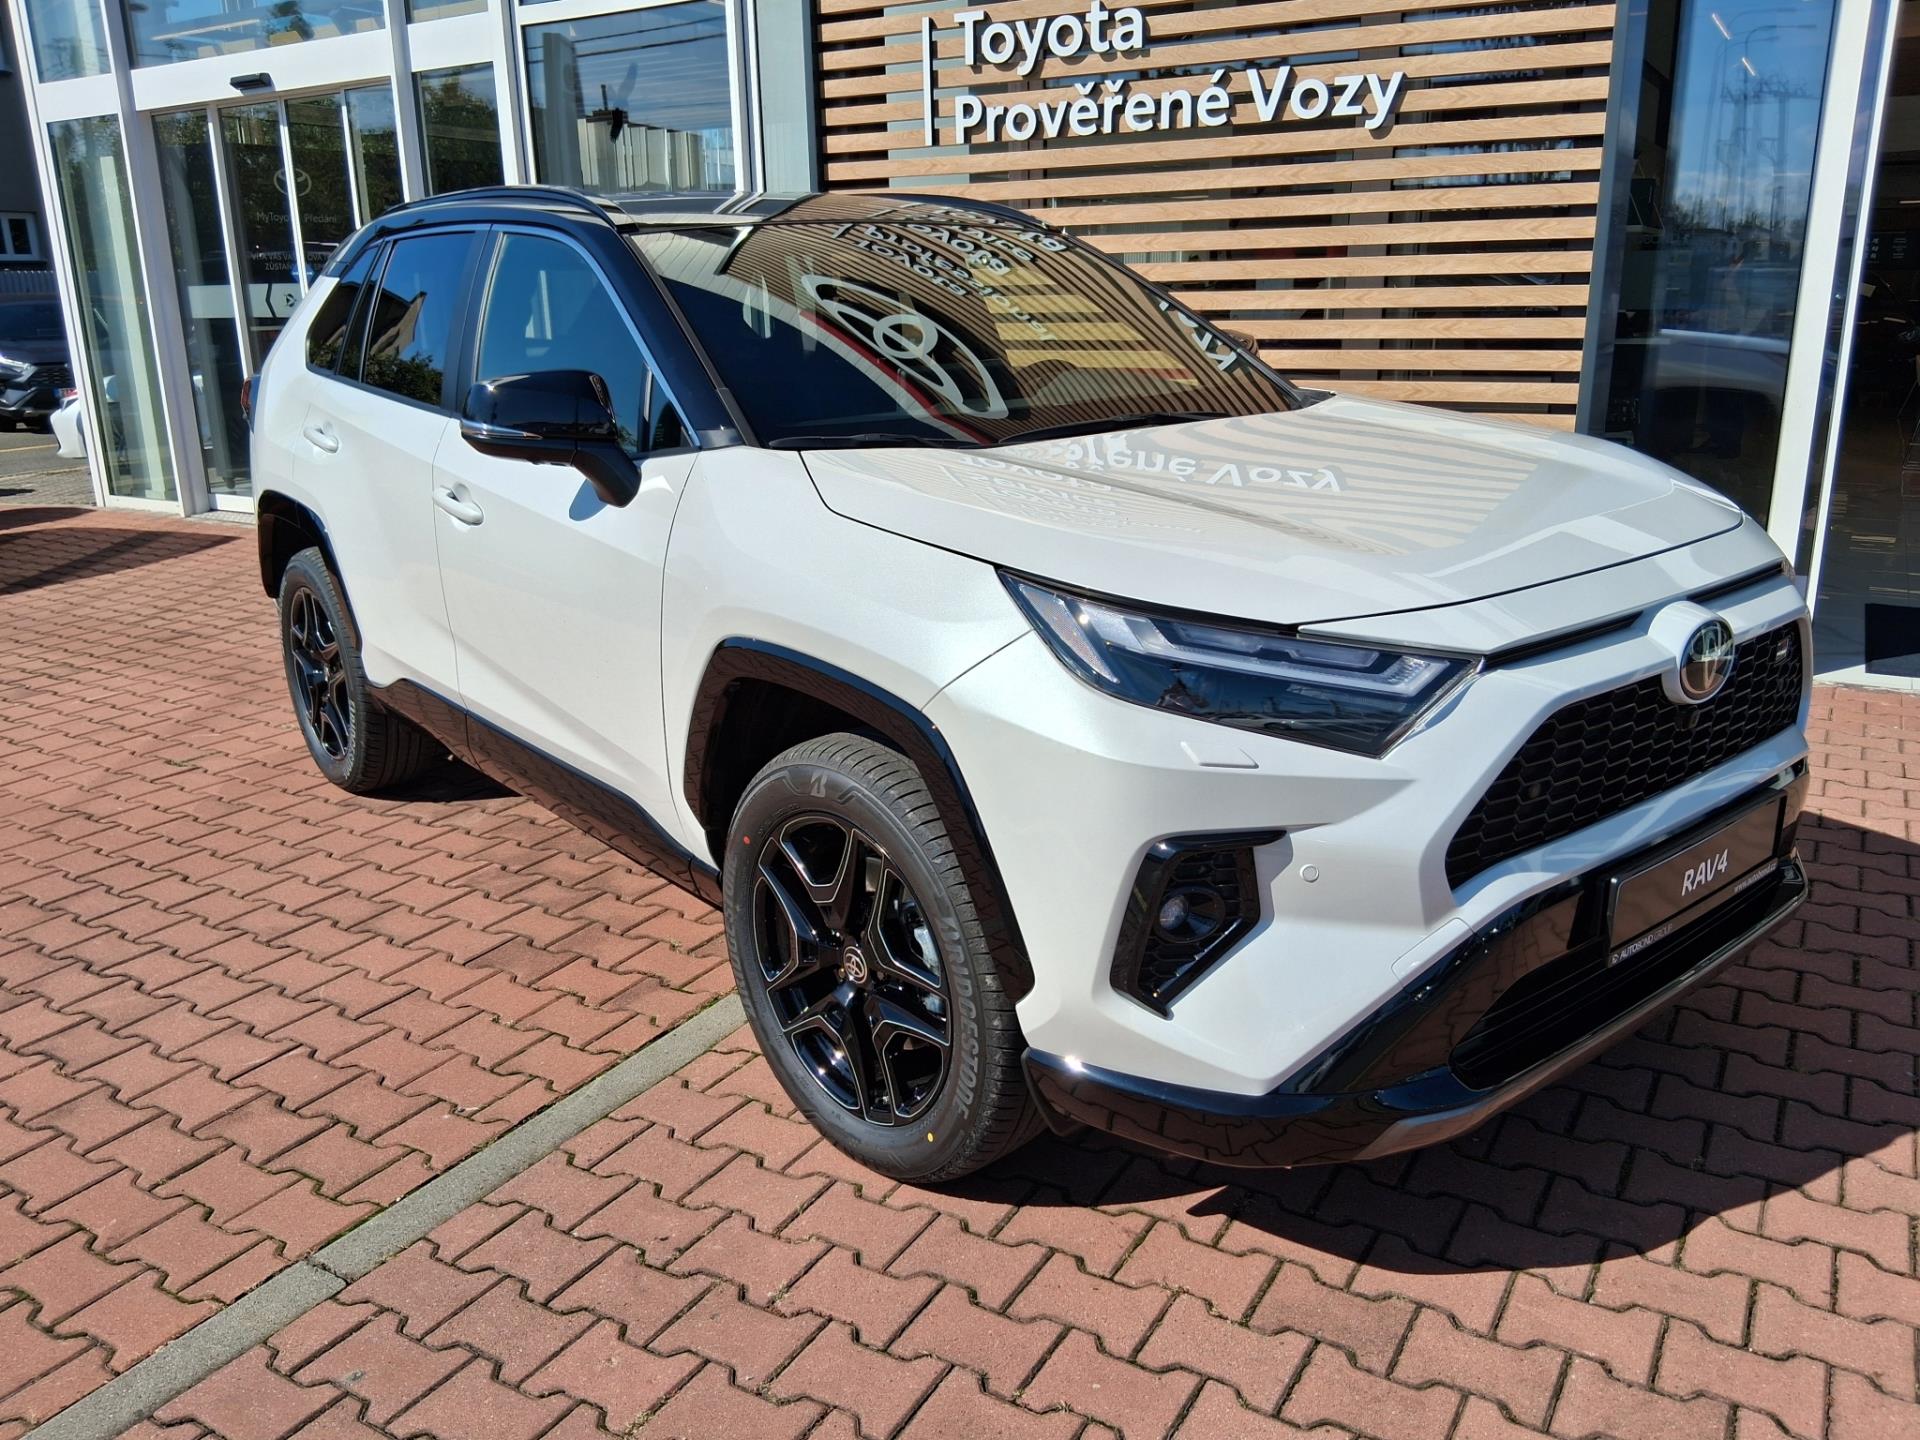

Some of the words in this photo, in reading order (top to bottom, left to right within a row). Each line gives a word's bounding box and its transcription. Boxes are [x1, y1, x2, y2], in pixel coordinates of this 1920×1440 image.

[953, 0, 1144, 76] Toyota
[955, 69, 1230, 145] Prověřené
[1246, 65, 1404, 130] Vozy
[1681, 849, 1728, 896] RAV4
[940, 915, 979, 1120] BRIDGESTONE
